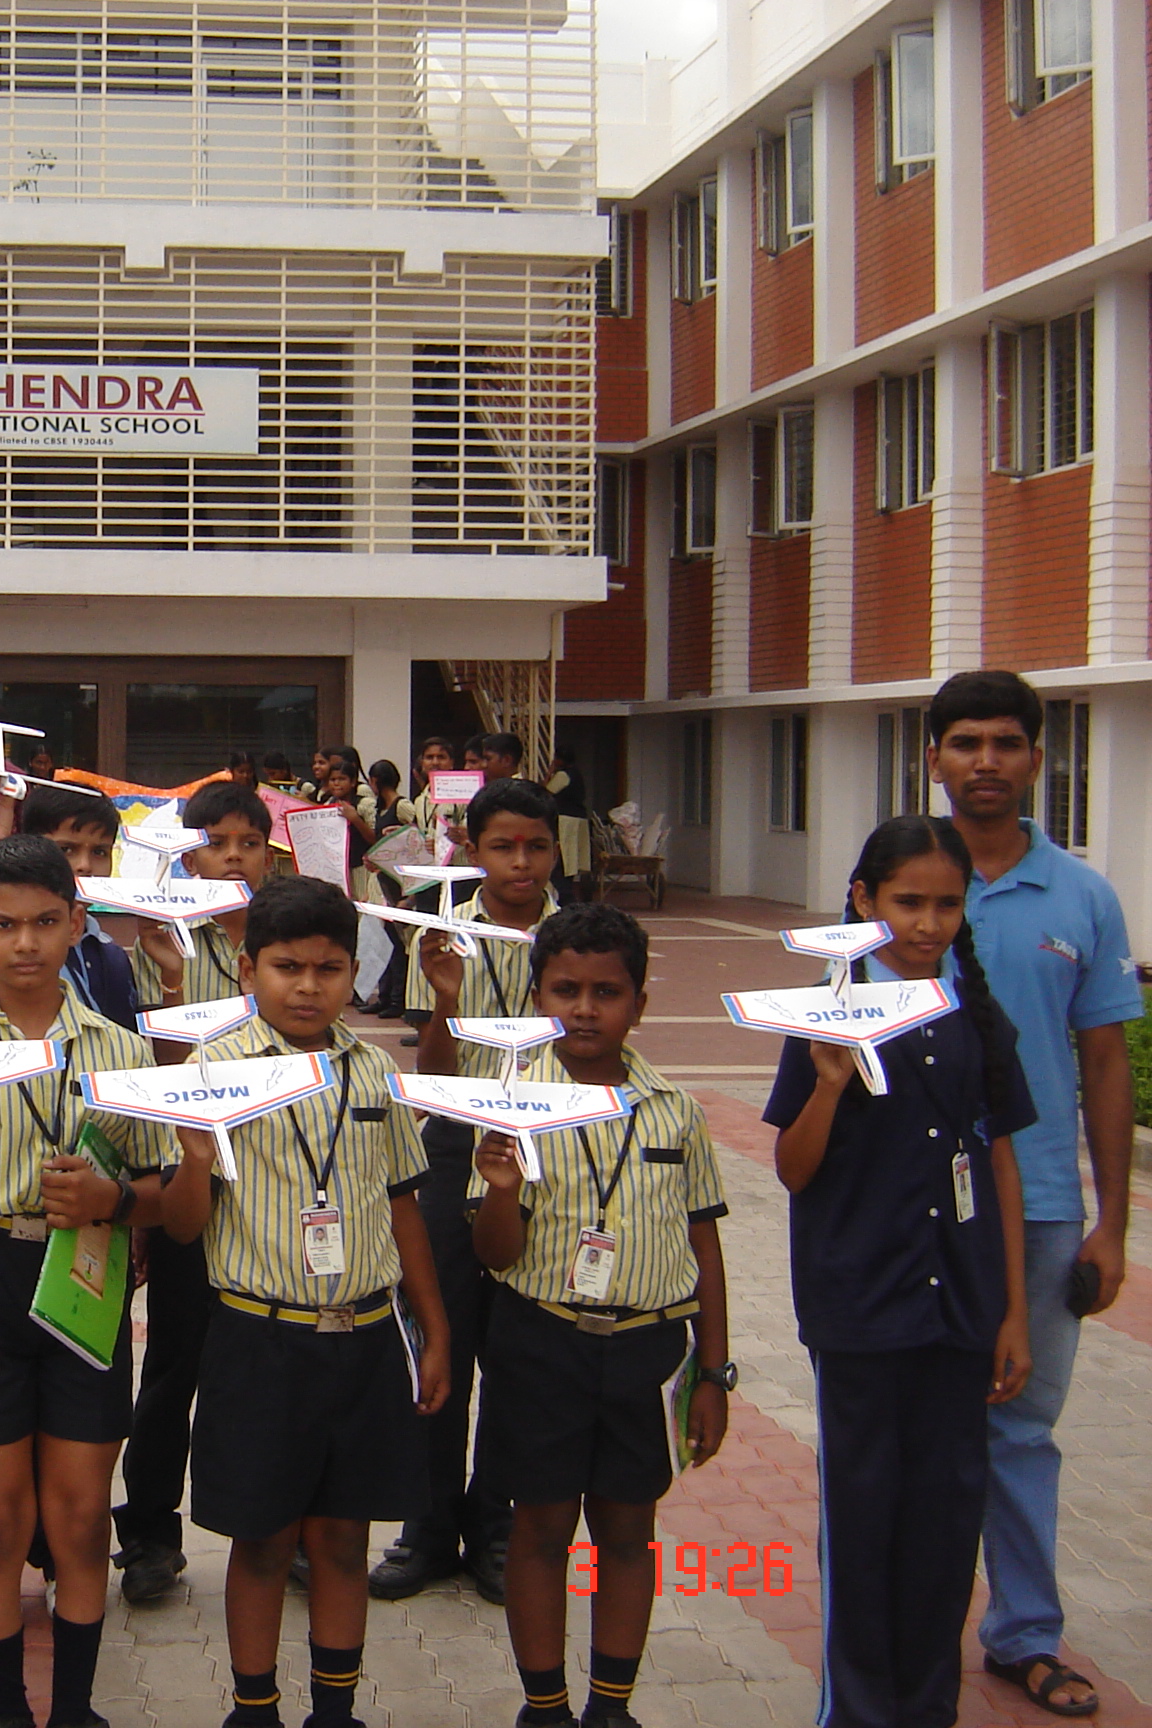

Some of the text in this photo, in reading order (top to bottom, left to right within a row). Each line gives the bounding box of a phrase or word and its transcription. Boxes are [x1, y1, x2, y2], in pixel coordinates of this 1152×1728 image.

[100, 416, 204, 435] SCHOOL
[30, 437, 40, 445] to
[43, 437, 68, 446] CBSE
[71, 437, 114, 446] 1930445
[132, 894, 197, 905] MAGIC
[824, 932, 852, 941] TASS
[806, 1005, 886, 1023] MAGIC
[163, 1085, 250, 1104] MAGIC
[469, 1098, 552, 1113] MAGIC
